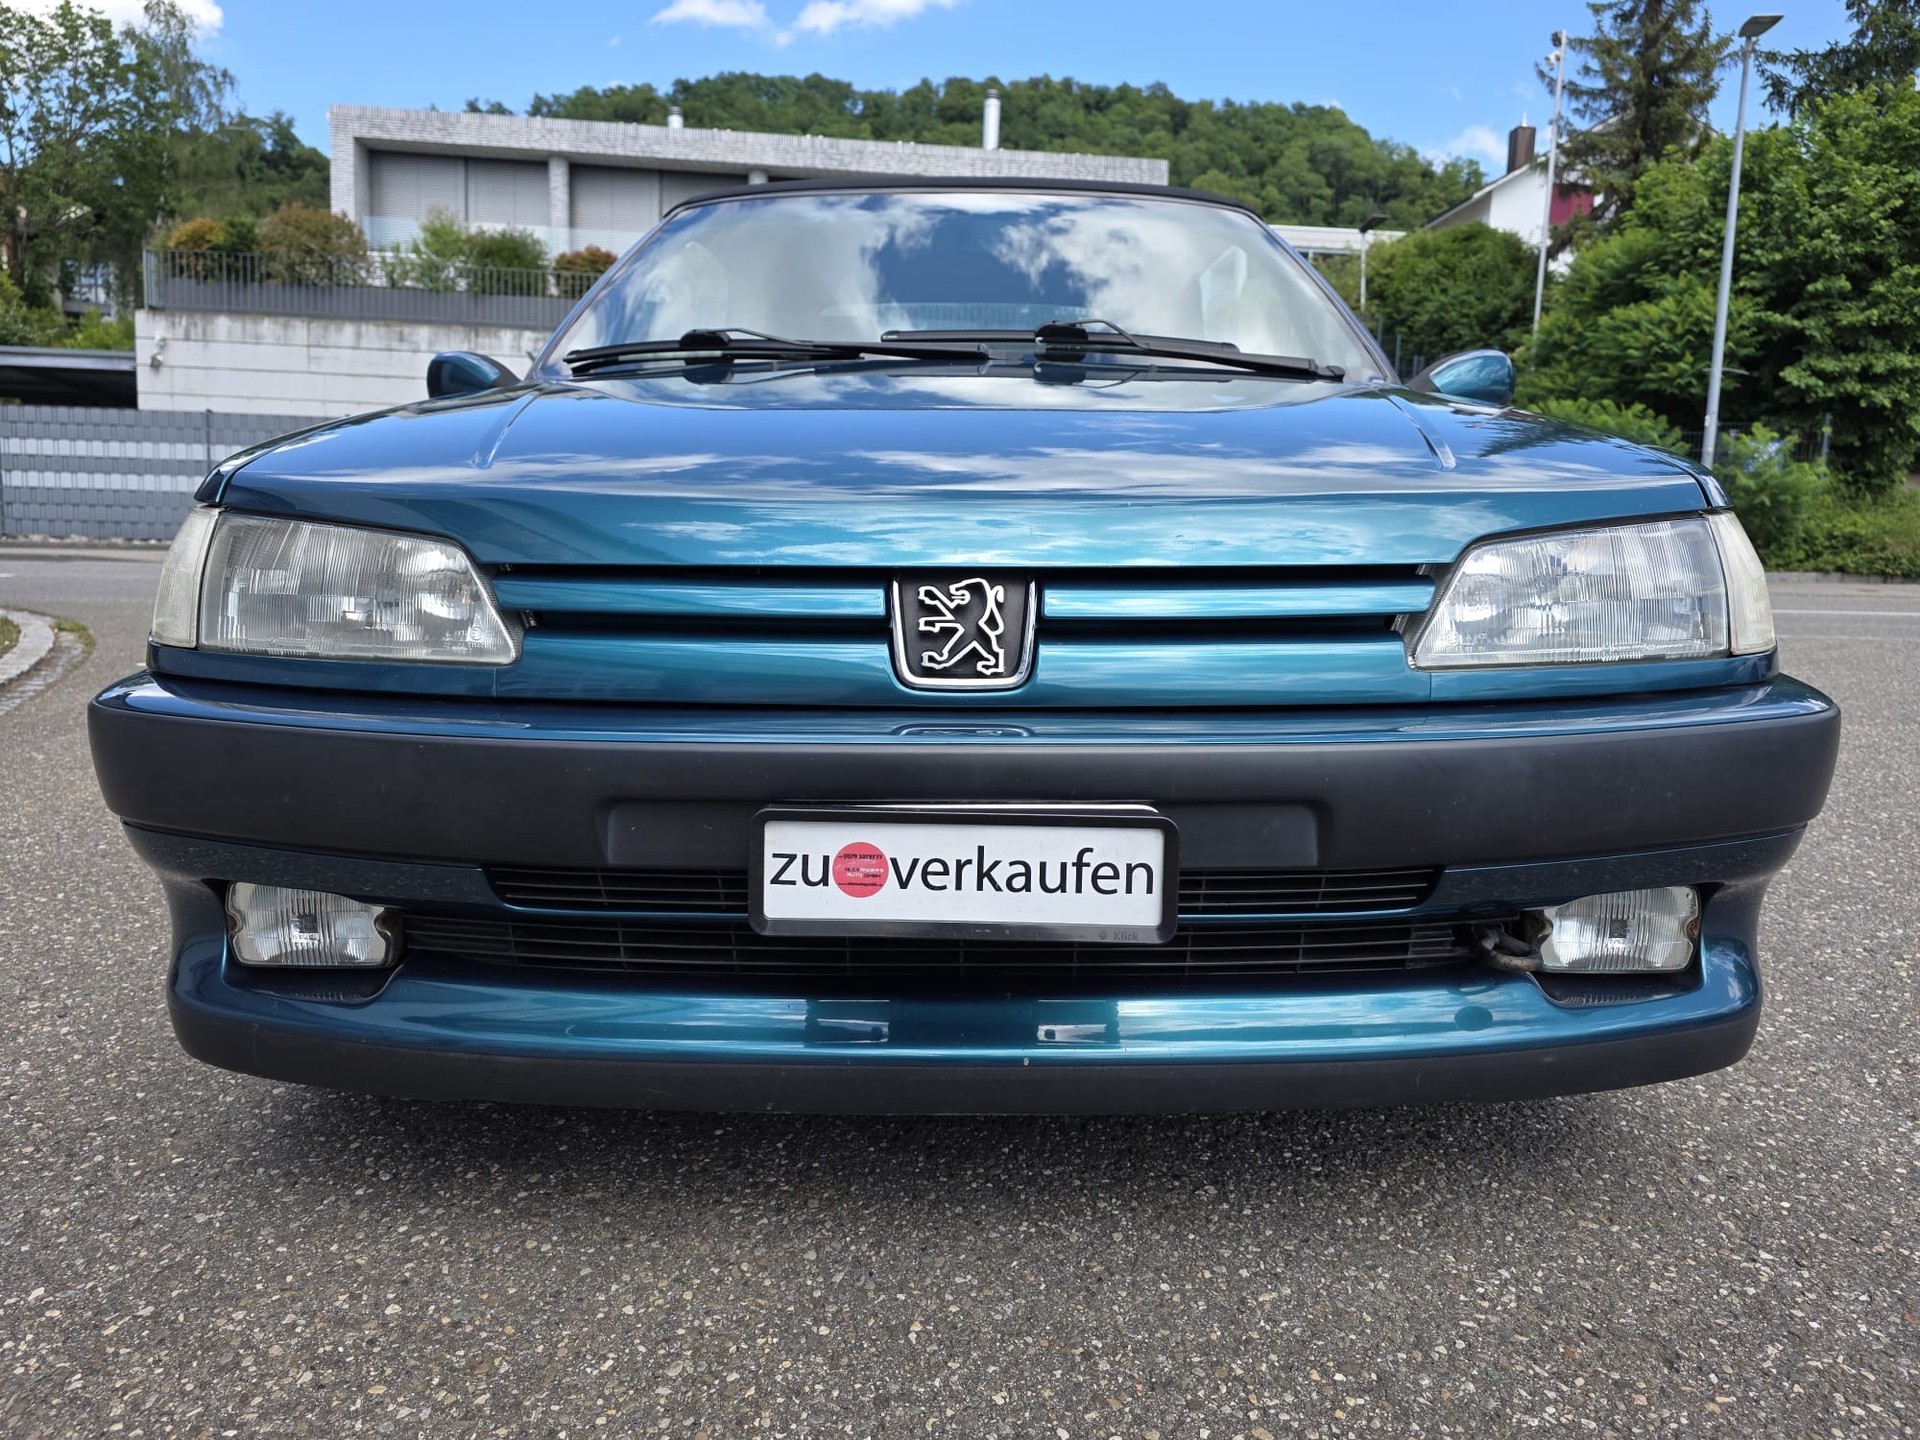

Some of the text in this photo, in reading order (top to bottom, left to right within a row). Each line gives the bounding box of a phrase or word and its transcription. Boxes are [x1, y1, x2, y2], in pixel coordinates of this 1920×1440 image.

[770, 845, 1154, 895] zu verkaufen
[1113, 931, 1139, 941] Klick
